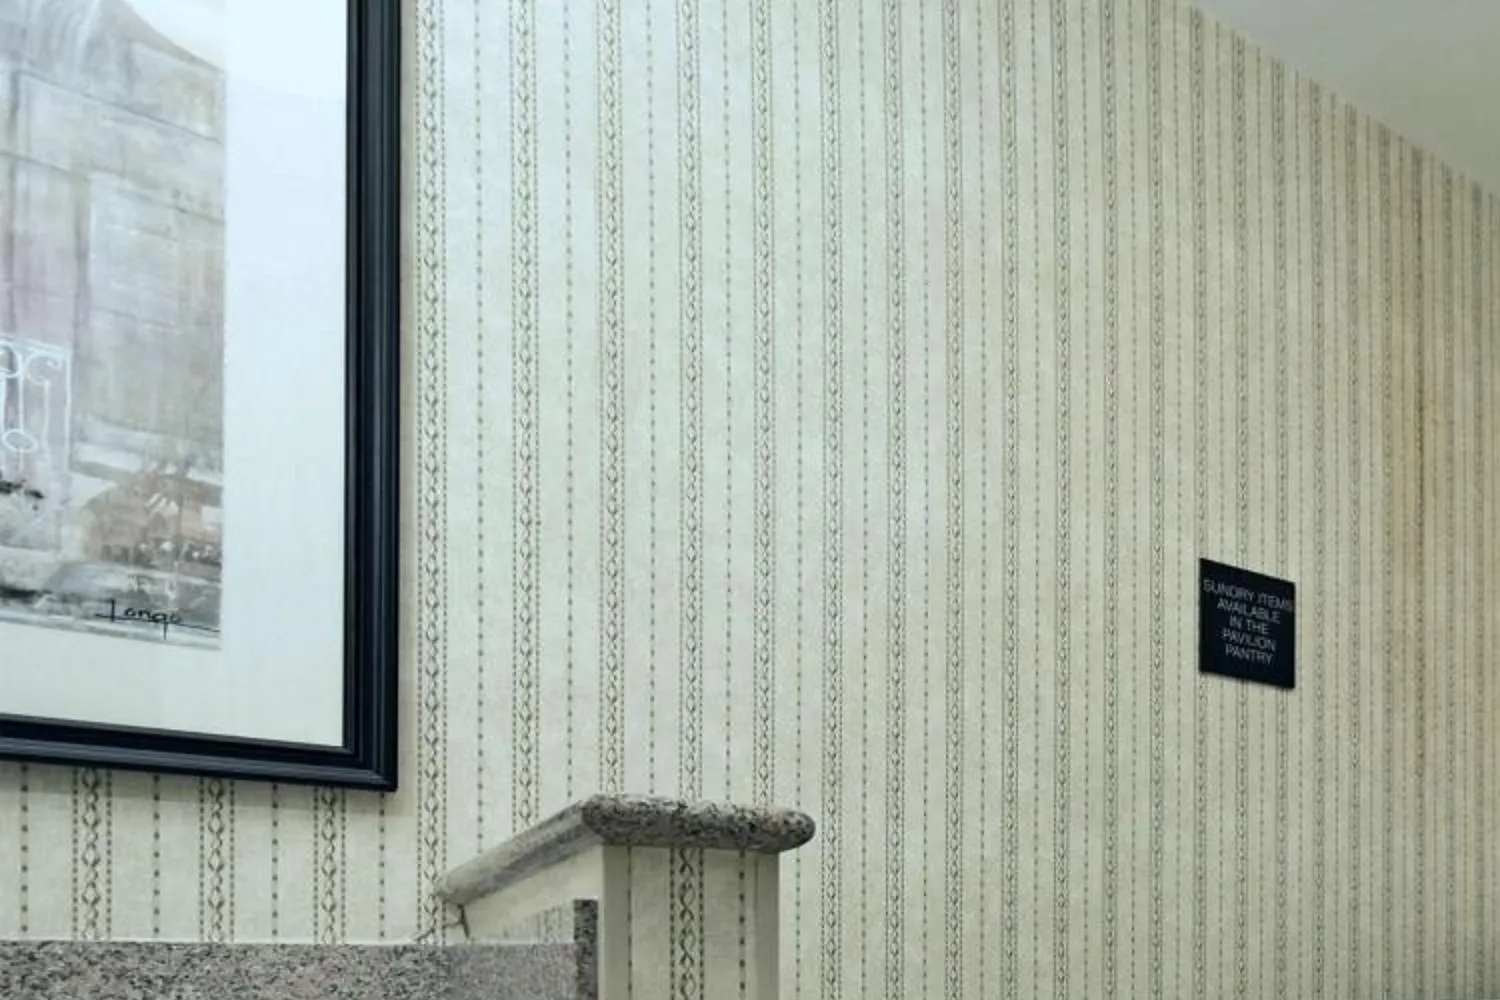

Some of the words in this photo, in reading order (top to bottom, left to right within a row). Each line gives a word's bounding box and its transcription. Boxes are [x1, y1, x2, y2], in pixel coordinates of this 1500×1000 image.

[1203, 579, 1255, 602] SUNDRY
[1217, 598, 1280, 624] AVAILABLE
[1229, 615, 1243, 629] IN
[1247, 619, 1270, 635] THE
[1221, 626, 1276, 652] PAVILION
[1225, 643, 1274, 665] PANTRY
